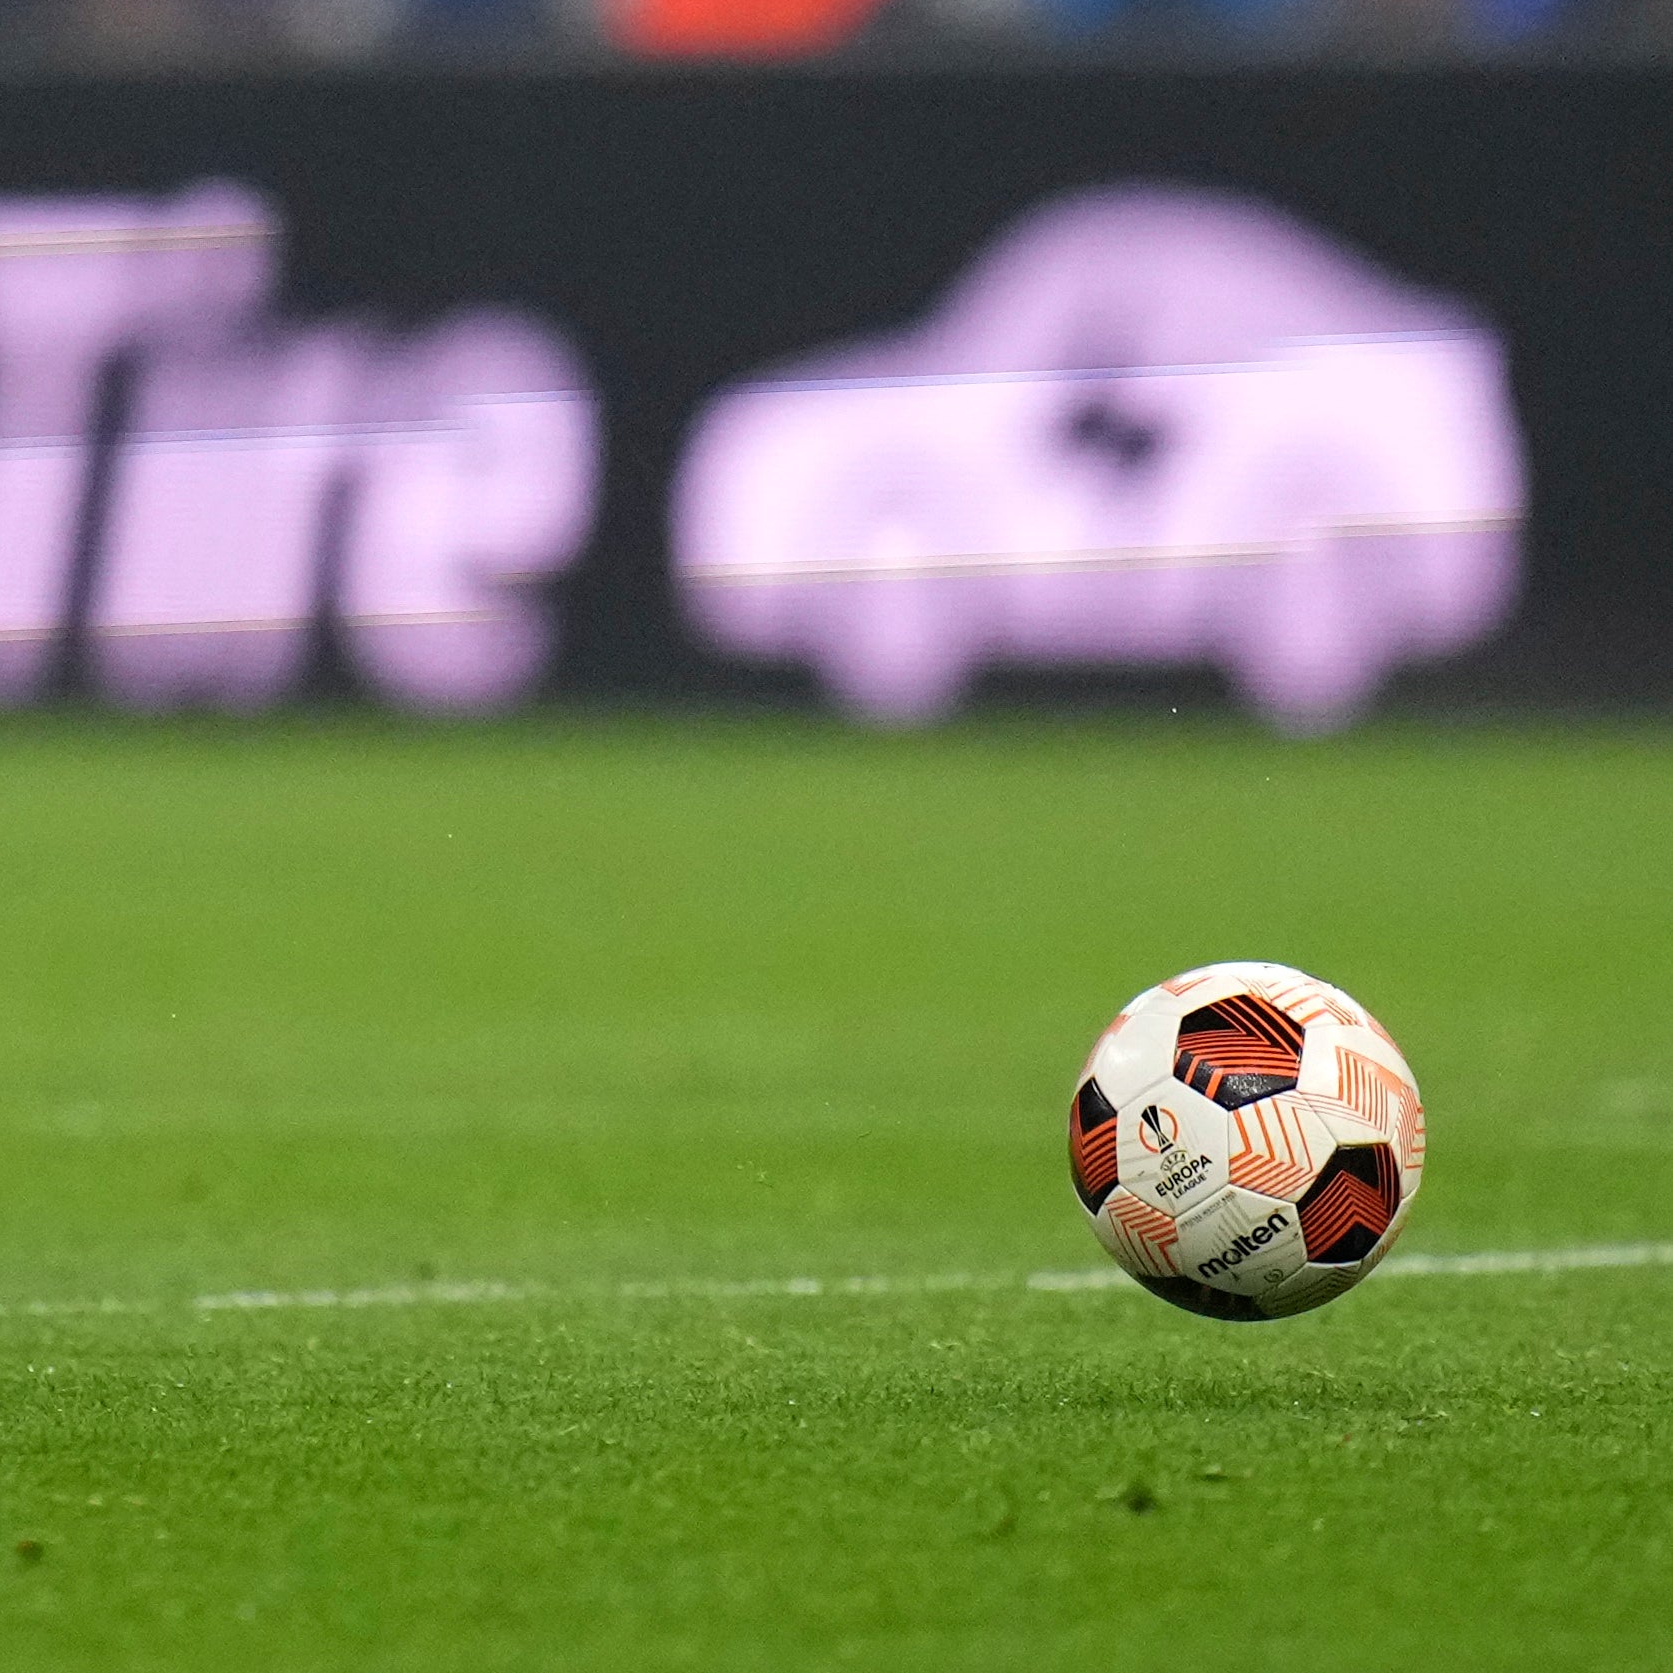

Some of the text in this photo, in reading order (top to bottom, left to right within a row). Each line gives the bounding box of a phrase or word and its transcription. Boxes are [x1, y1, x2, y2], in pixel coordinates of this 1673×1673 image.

[1155, 1154, 1213, 1197] EUROPA
[1173, 1172, 1207, 1199] LEAGUE
[1198, 1213, 1290, 1278] molten
